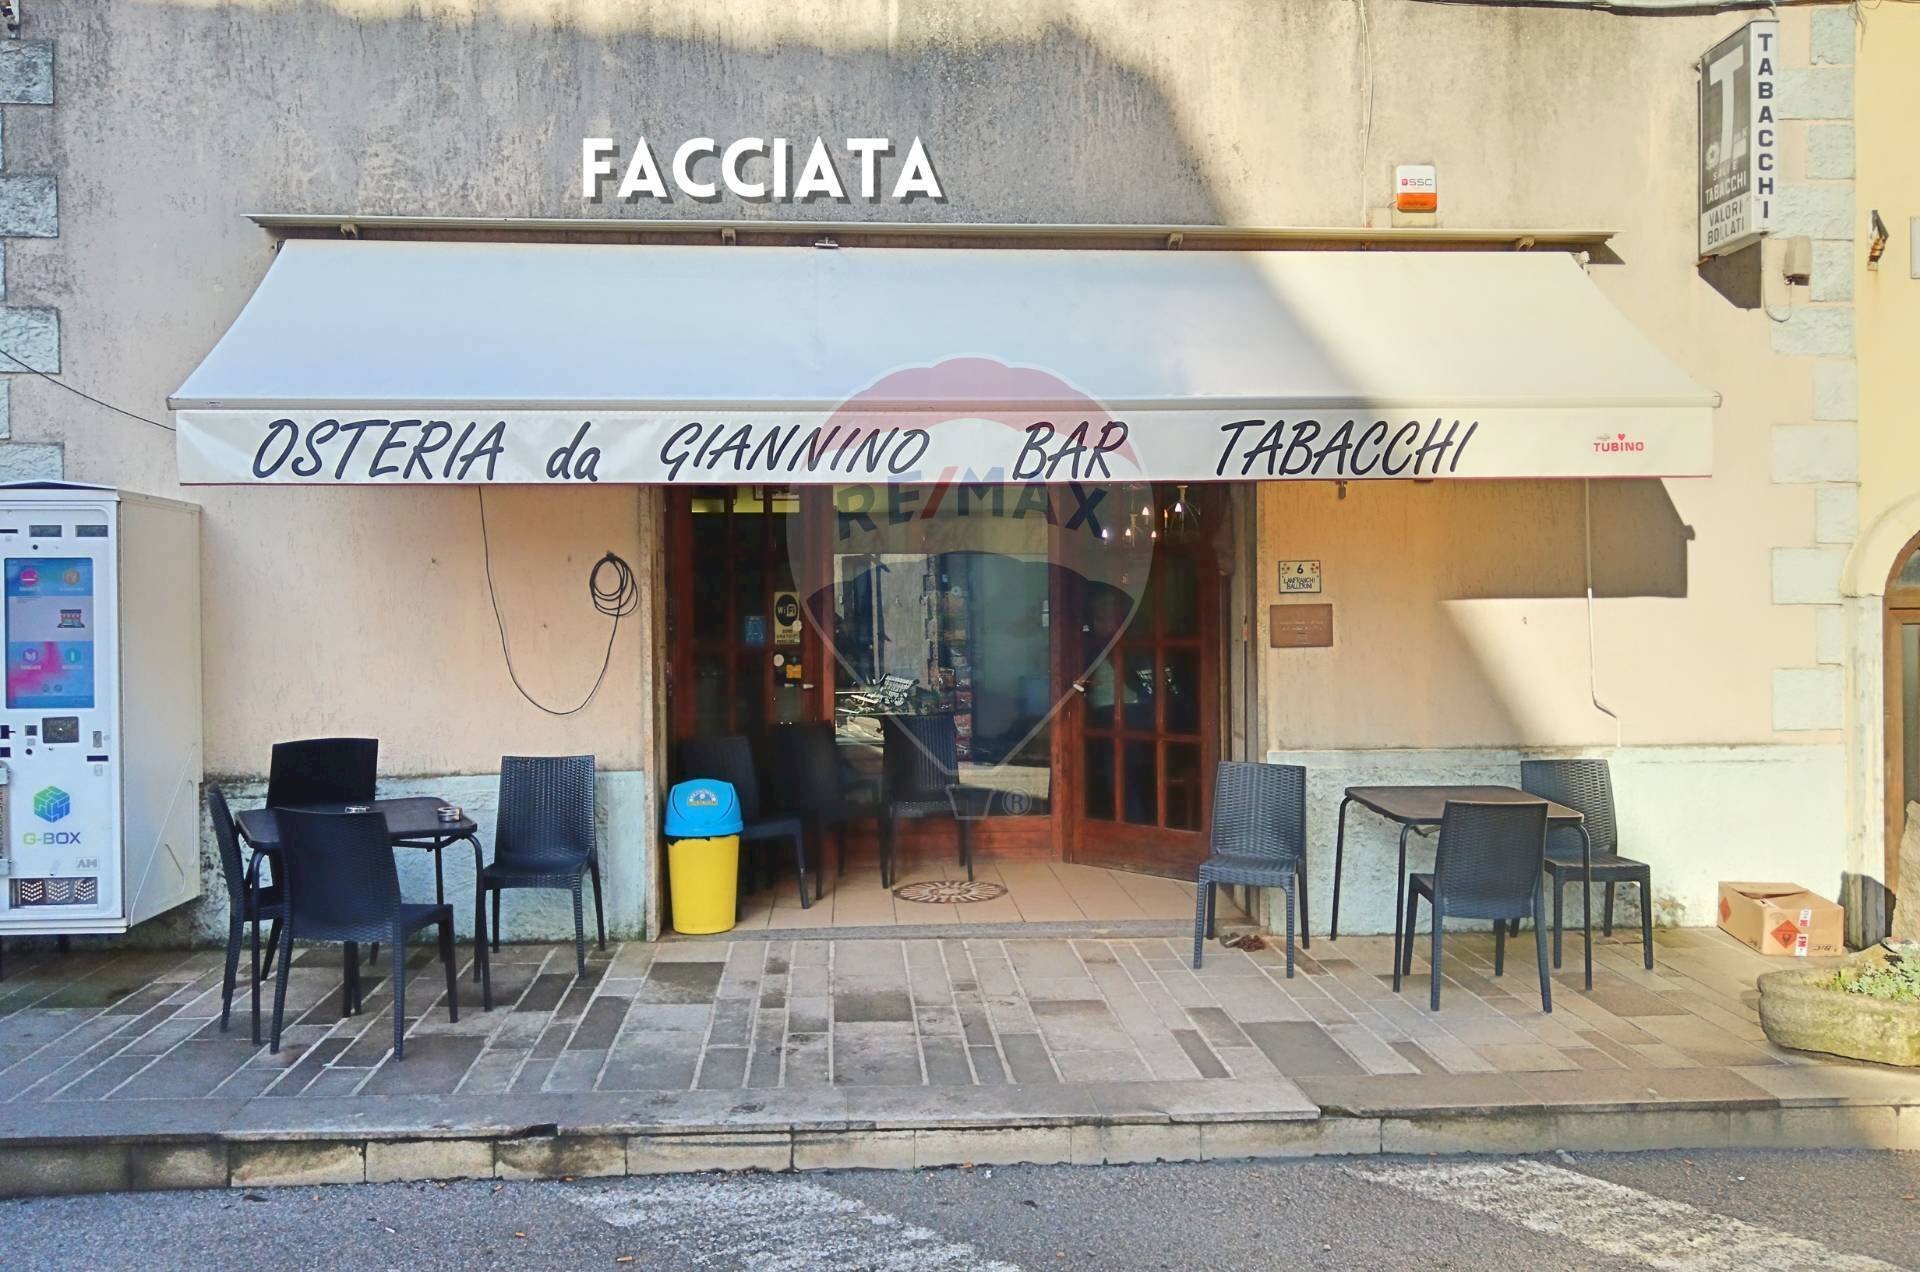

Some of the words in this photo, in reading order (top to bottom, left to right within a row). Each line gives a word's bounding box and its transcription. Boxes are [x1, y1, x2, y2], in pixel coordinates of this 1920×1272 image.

[1757, 33, 1774, 219] TABACCHI
[1409, 178, 1433, 186] SSC
[1704, 170, 1746, 204] TABACCHI
[1709, 200, 1742, 227] VALORI
[1707, 216, 1744, 245] BOLLATI
[252, 419, 506, 481] OSTERIA
[545, 421, 600, 482] da
[659, 421, 931, 481] GIANNINO
[1012, 420, 1129, 480] BAR
[1216, 417, 1479, 477] TABACCHI
[1593, 442, 1645, 452] TUBINO
[1296, 563, 1304, 574] 6
[23, 832, 81, 845] G-BOX
